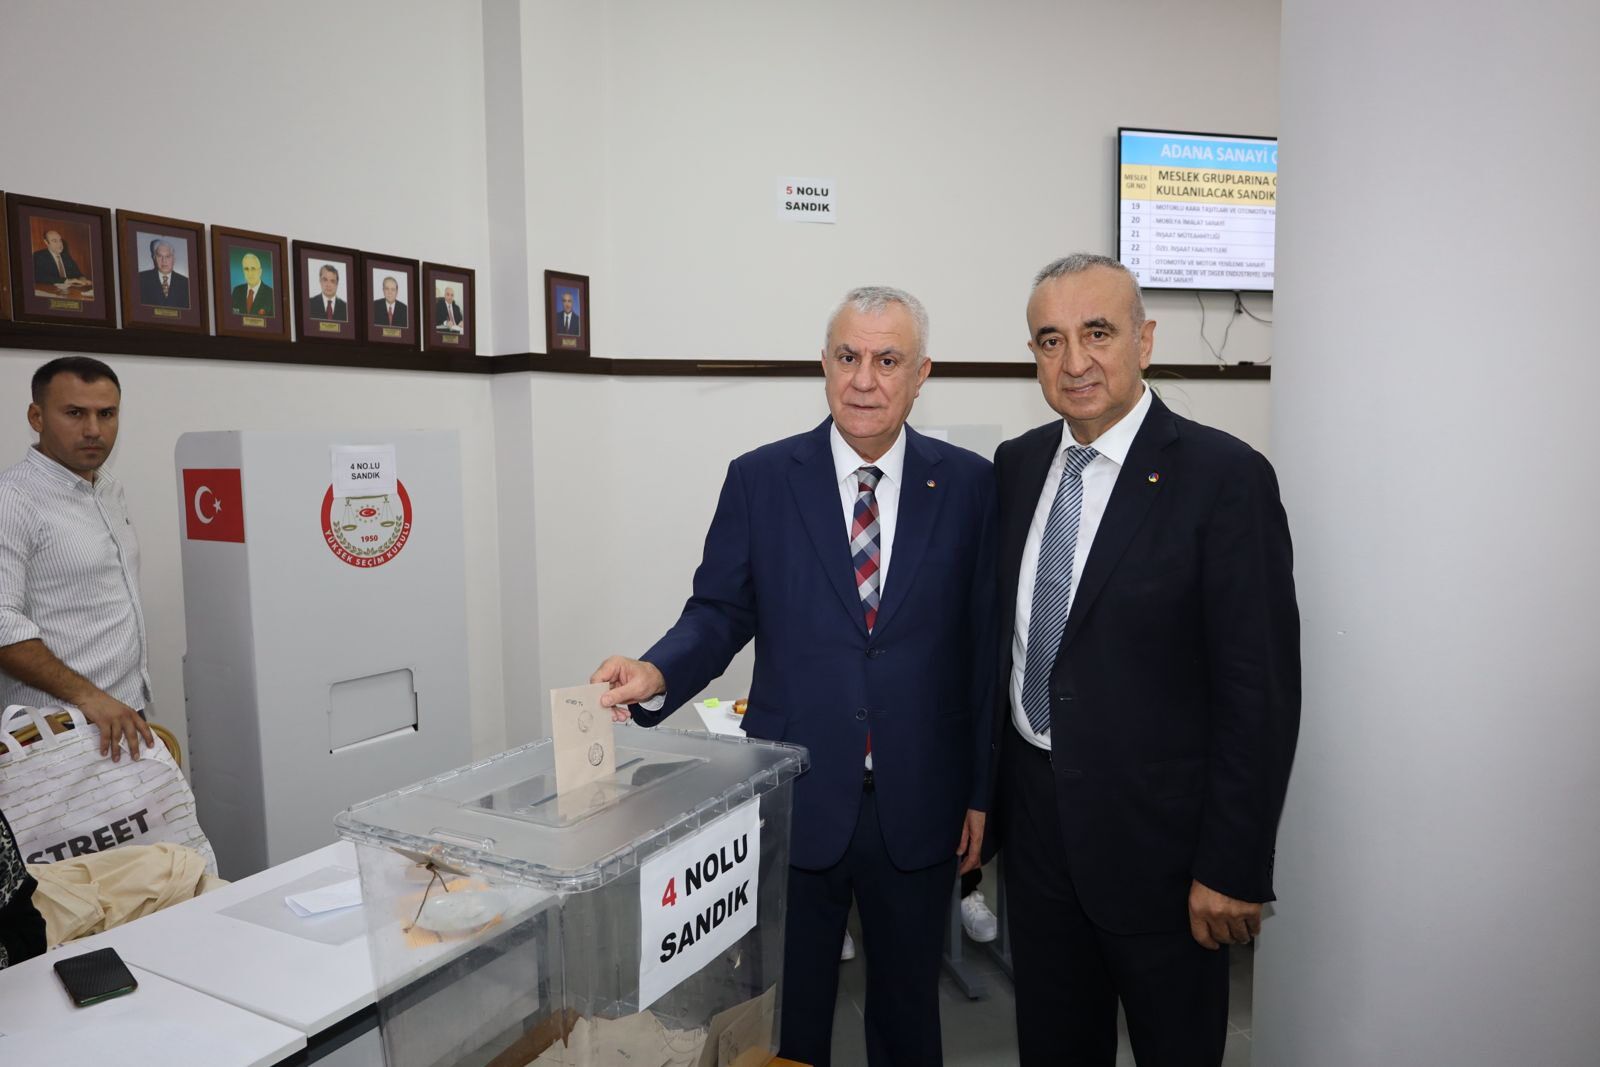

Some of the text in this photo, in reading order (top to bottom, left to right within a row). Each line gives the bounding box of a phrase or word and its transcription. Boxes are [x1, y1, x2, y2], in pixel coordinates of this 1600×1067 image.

[1161, 143, 1214, 160] ADANA
[1217, 146, 1268, 164] SANAYİ
[1158, 170, 1200, 182] MESLEK
[1202, 172, 1270, 186] GRUPLARINA
[786, 186, 829, 197] 5 NOLU
[1156, 185, 1234, 199] KULLANILACAK
[785, 201, 830, 212] SANDIK
[1131, 202, 1140, 210] 19
[1131, 216, 1140, 224] 20
[1131, 230, 1139, 238] 21
[1131, 243, 1140, 251] 22
[1131, 257, 1140, 265] 23
[351, 472, 380, 480] SANDIK
[361, 534, 379, 543] 1950
[325, 522, 410, 568] YÜKSEK SEÇİM KURULU
[26, 808, 149, 865] STREET
[662, 833, 748, 908] 4 NOLU
[659, 880, 750, 964] SANDIK
